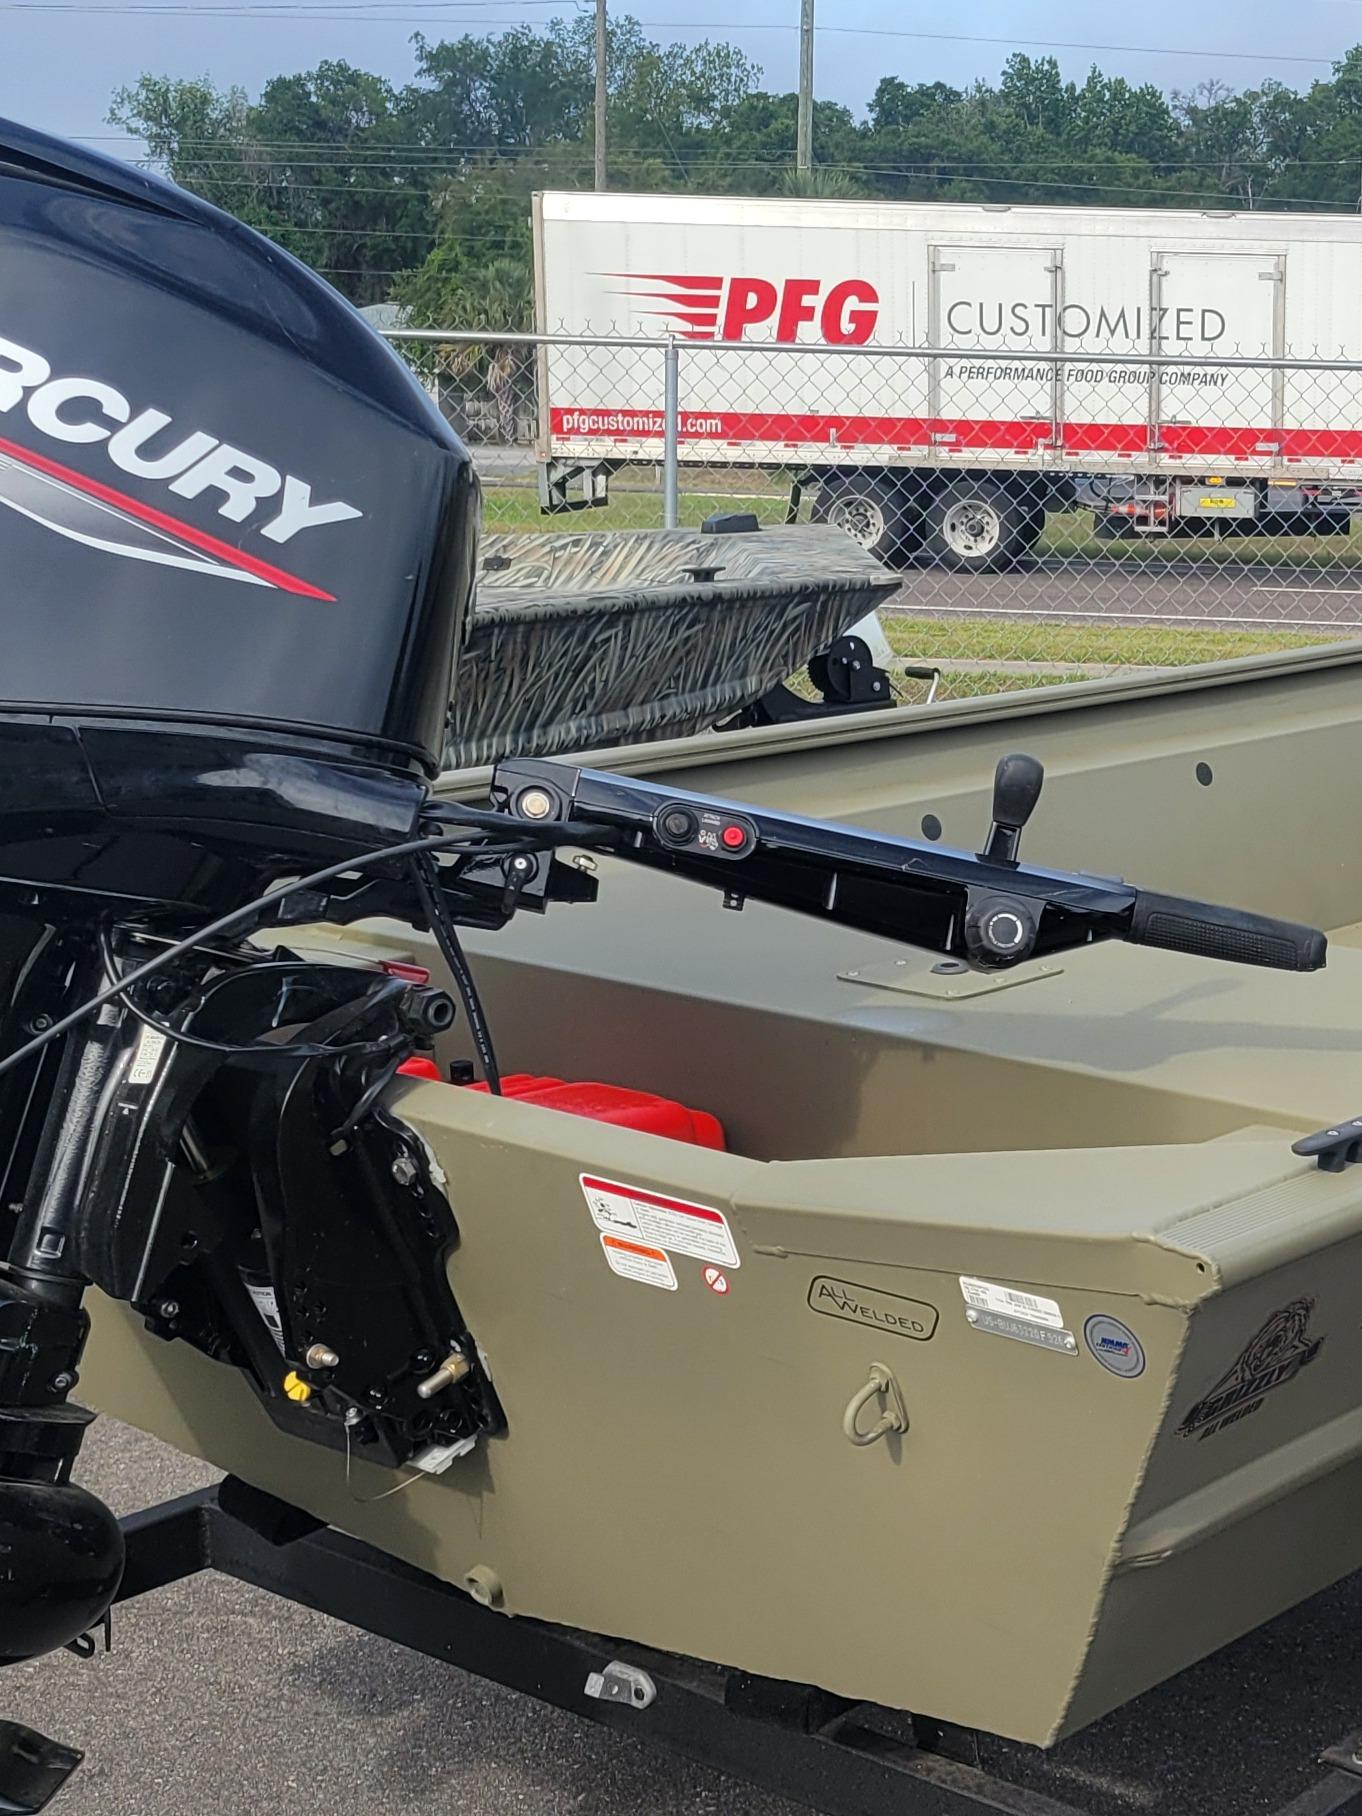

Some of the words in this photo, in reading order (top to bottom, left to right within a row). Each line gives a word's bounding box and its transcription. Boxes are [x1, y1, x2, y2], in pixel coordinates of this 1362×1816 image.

[722, 277, 879, 346] PFG
[947, 301, 1226, 342] CUSTOMIZED
[944, 366, 954, 379] A
[958, 366, 1062, 382] PERFORMANCE
[1066, 368, 1103, 383] FOOD
[1108, 369, 1156, 385] GROUP
[1159, 371, 1229, 387] COMPANY
[562, 411, 721, 434] pfgcustomiz.com
[818, 1284, 855, 1302] ALL
[833, 1298, 925, 1333] WELDED
